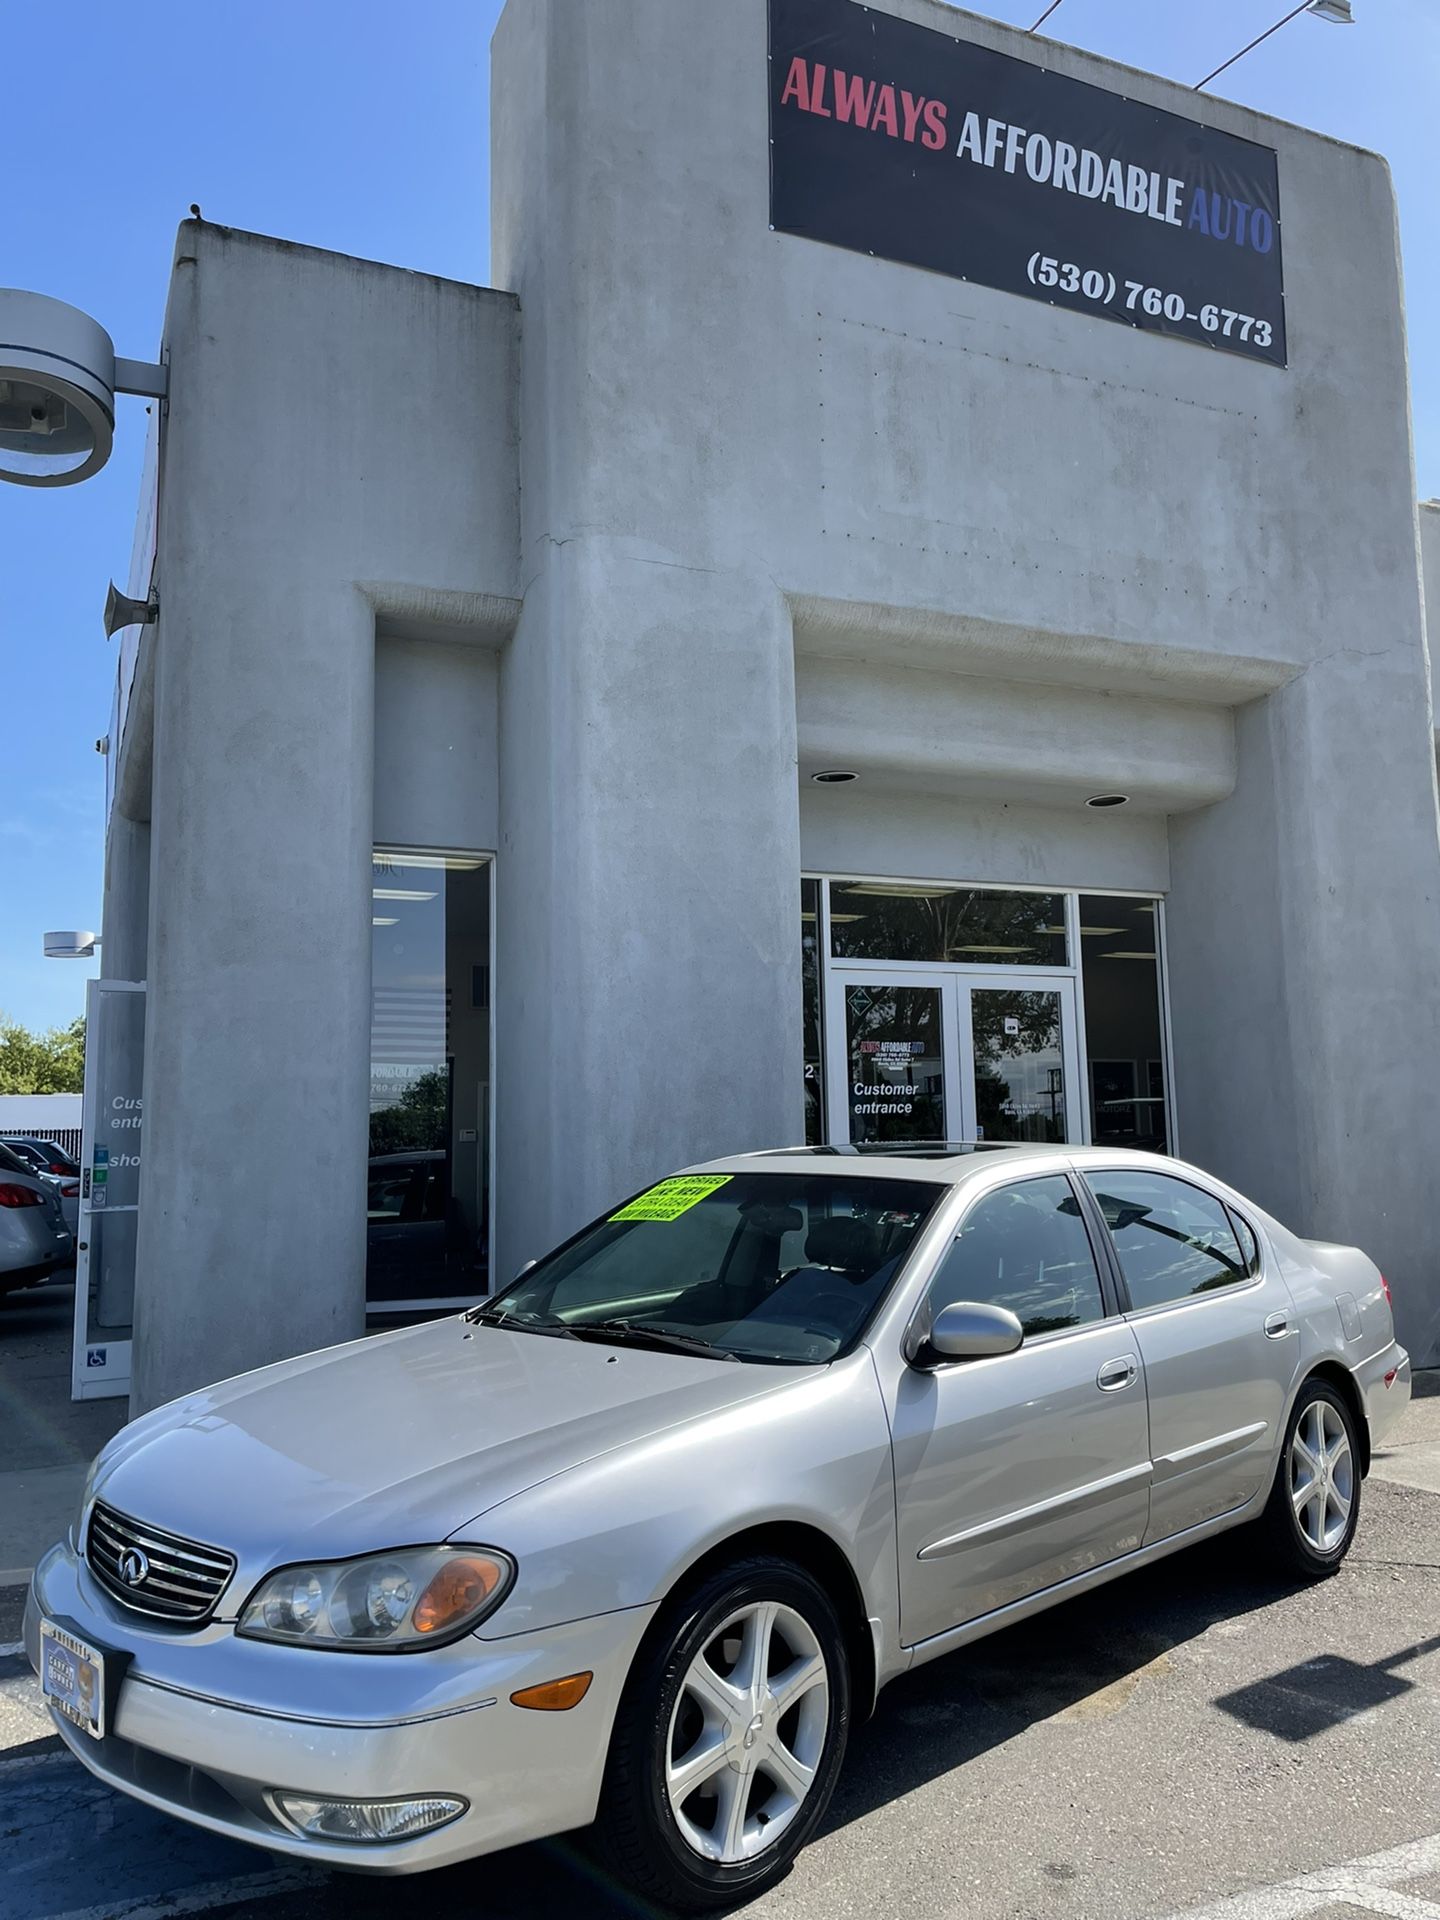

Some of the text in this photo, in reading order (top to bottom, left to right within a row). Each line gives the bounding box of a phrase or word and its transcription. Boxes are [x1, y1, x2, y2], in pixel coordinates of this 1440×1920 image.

[781, 56, 1273, 255] ALWAYS AFFORDABLE AUTO
[1027, 252, 1273, 347] (530) 760-6773
[805, 1064, 814, 1078] 2
[854, 1082, 919, 1096] Customer
[854, 1101, 913, 1114] entrance
[109, 1153, 141, 1167] sho
